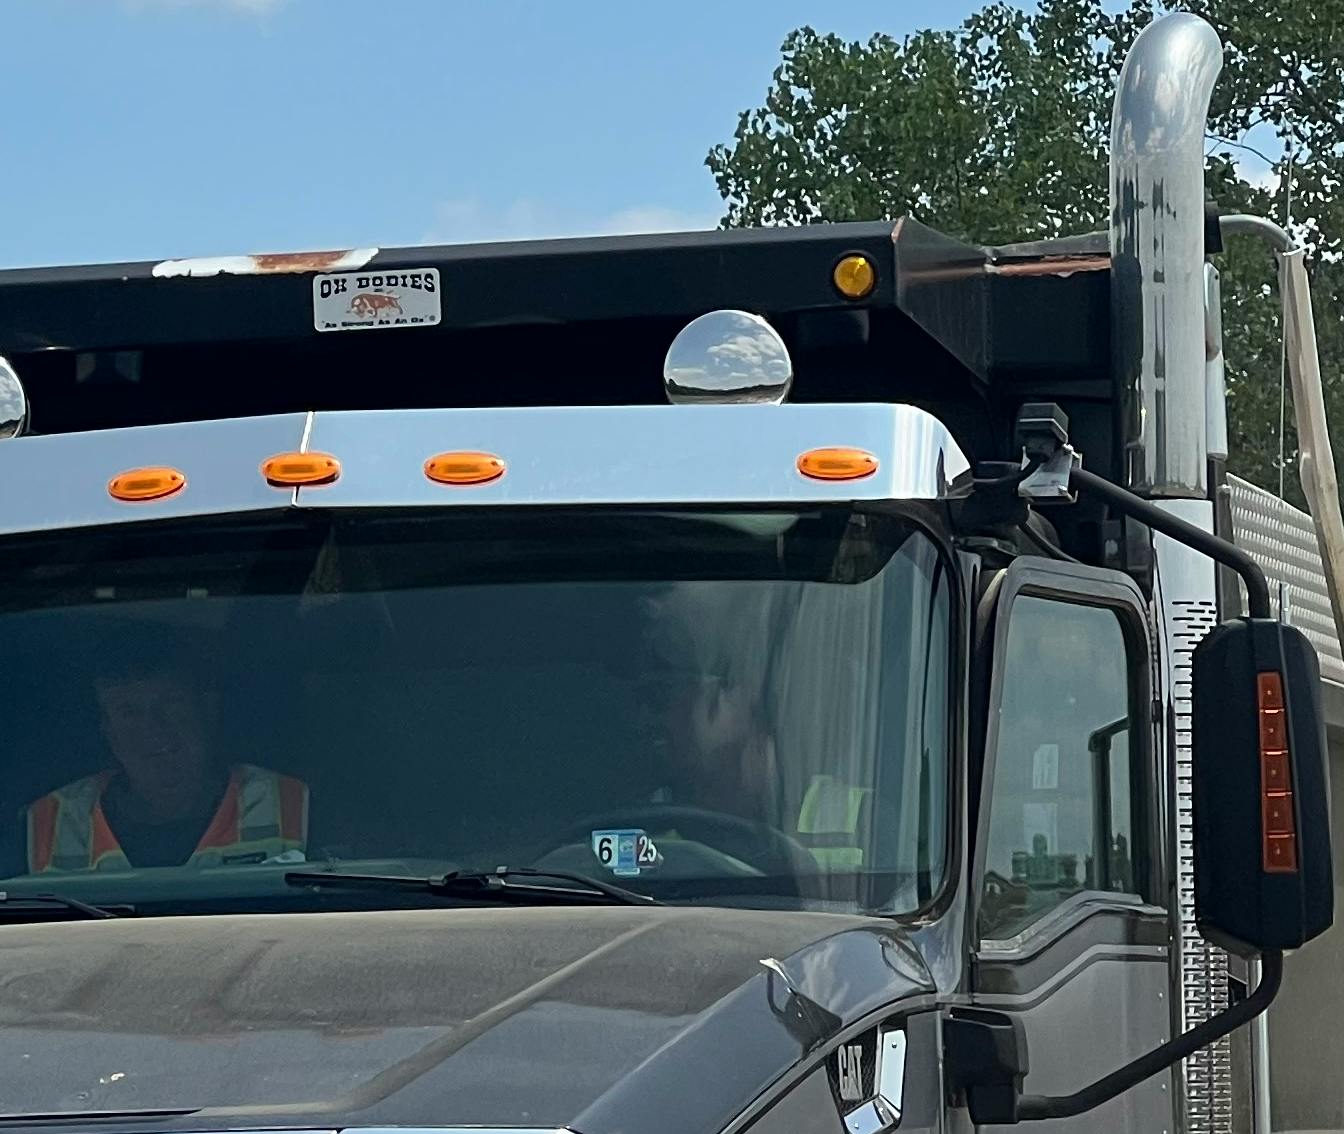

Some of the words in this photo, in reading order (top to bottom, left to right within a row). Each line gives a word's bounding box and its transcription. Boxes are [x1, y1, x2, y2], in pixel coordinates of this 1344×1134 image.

[320, 279, 348, 298] OX
[357, 273, 435, 293] BODIES
[599, 837, 613, 864] 6
[639, 835, 657, 862] 25
[838, 1044, 864, 1101] CAT
